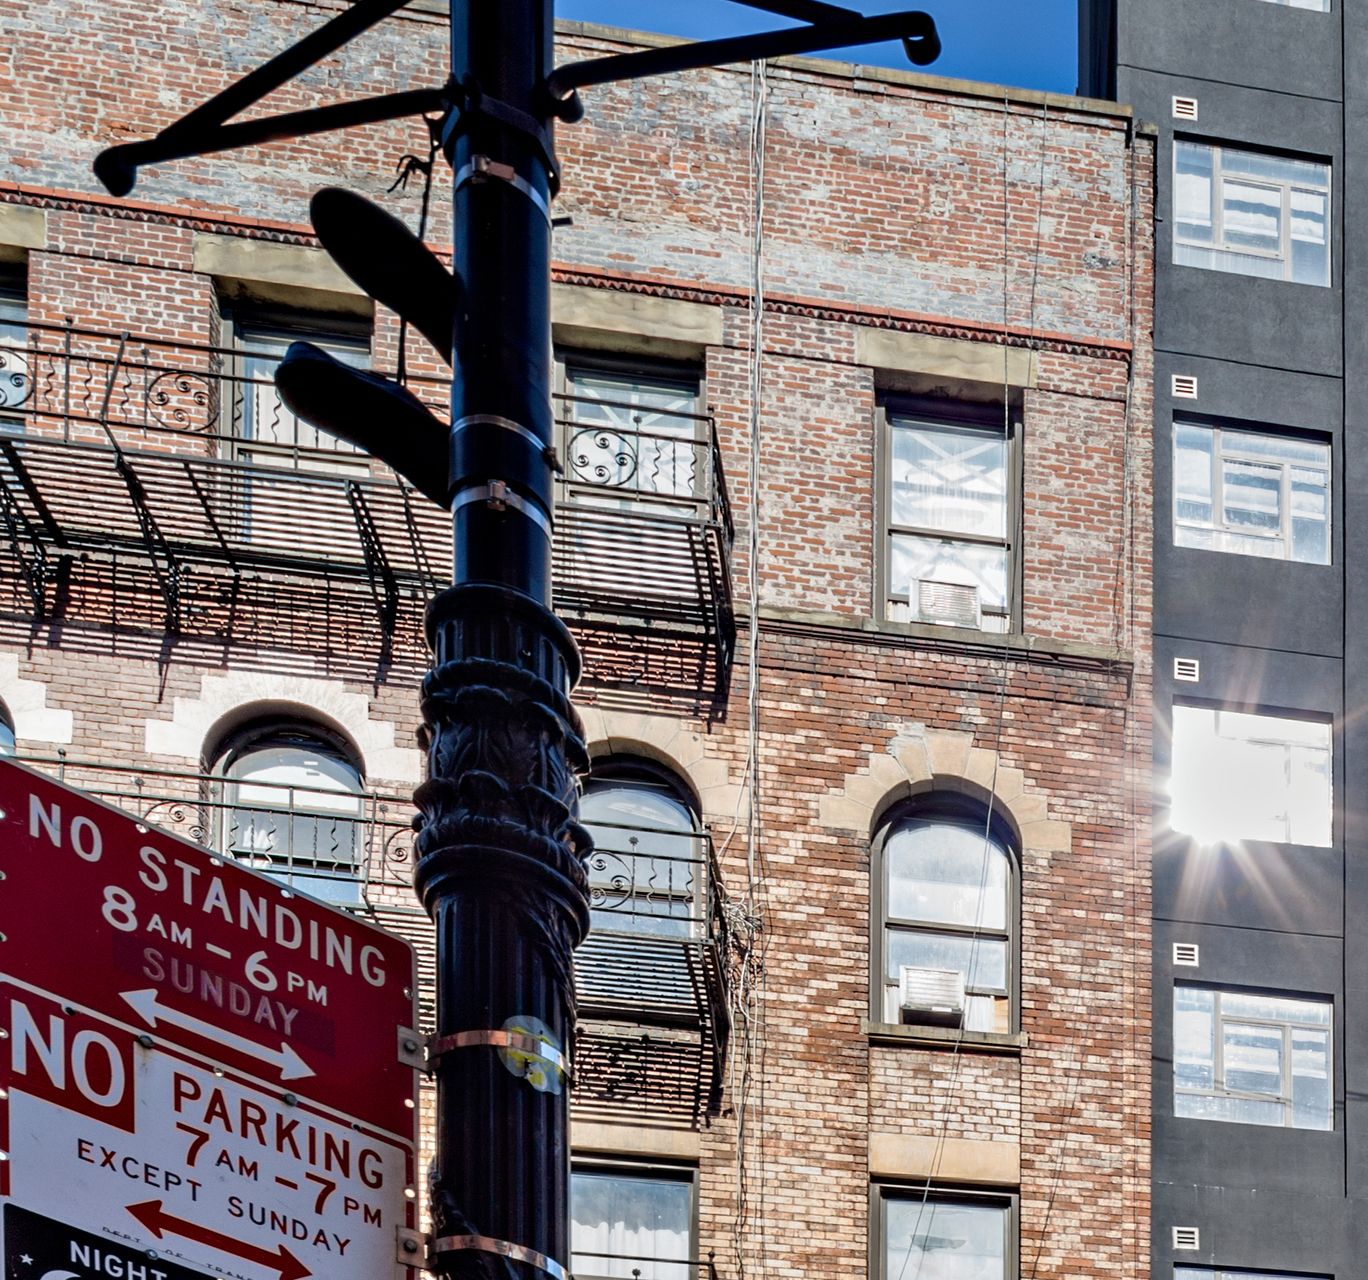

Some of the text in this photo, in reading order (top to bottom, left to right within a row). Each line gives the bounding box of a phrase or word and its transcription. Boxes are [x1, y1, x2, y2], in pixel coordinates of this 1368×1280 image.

[29, 793, 386, 987] NO STANDING
[142, 947, 299, 1036] SUNDAY
[10, 999, 125, 1108] NO
[173, 1071, 384, 1189] PARKING
[77, 1138, 351, 1256] EXCEPT SUNDAY
